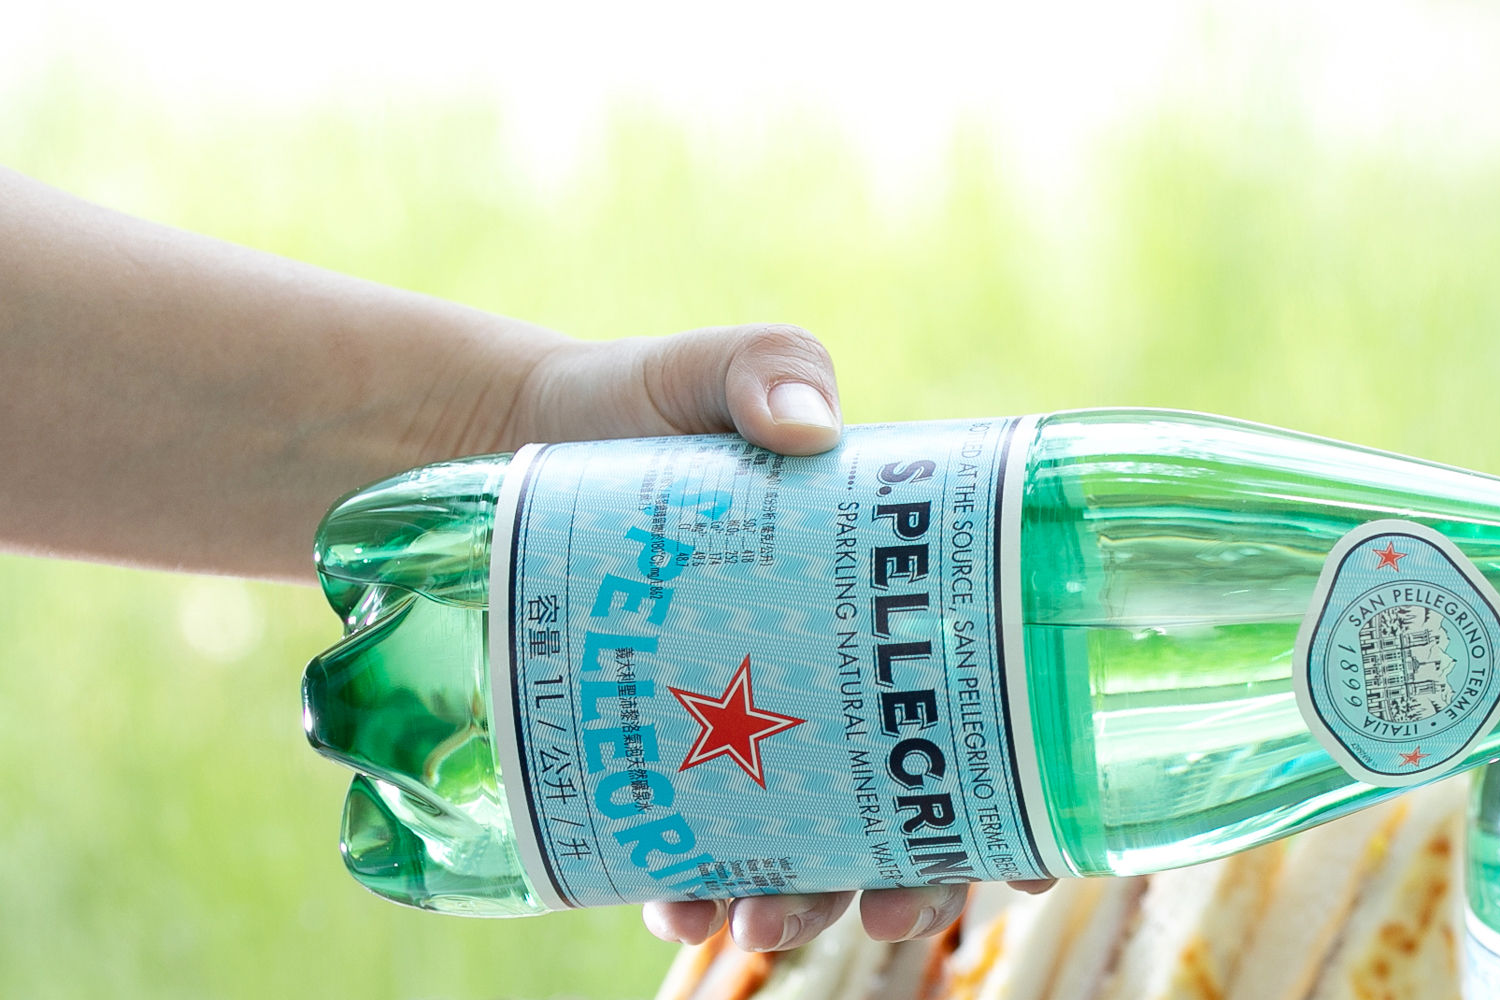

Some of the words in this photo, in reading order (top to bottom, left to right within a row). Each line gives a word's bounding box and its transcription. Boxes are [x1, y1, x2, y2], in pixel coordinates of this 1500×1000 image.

[958, 463, 978, 478] AT
[953, 483, 977, 513] THE
[708, 551, 722, 566] 174
[724, 550, 738, 565] 252
[741, 549, 755, 564] 418
[835, 502, 860, 620] SPARKLING
[949, 520, 974, 611] SOURCE,
[649, 586, 664, 600] 862
[527, 594, 561, 660] 容量
[953, 620, 979, 669] SAN
[1338, 643, 1363, 709] 1899
[1348, 594, 1386, 628] SAN
[1392, 587, 1486, 660] PELLEGRINO
[1447, 668, 1486, 721] TERME
[533, 675, 565, 709] 1L
[836, 631, 868, 741] NATURAL
[957, 676, 995, 801] PELLEGRINO
[1363, 715, 1419, 738] ITALIA
[539, 745, 579, 805] 公升
[848, 750, 886, 836] MINERAL
[556, 838, 592, 861] 升
[977, 804, 1008, 853] TERME
[869, 841, 904, 882] WATER
